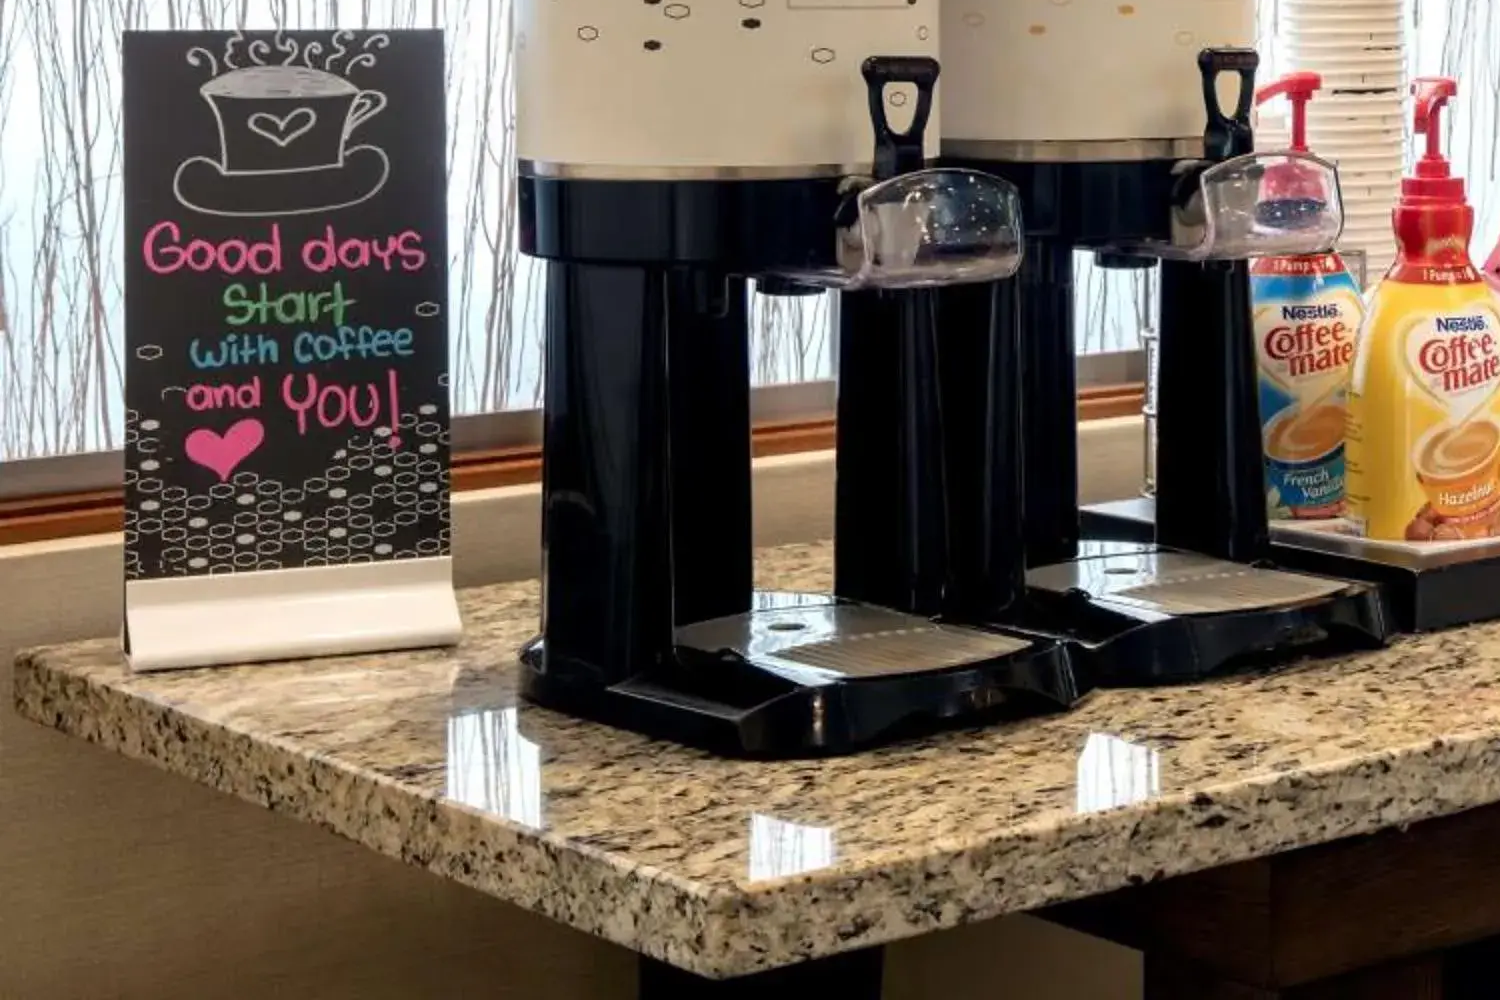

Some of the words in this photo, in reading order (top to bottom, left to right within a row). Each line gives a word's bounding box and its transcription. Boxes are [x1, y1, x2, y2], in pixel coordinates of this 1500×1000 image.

[143, 220, 282, 274] Good
[302, 224, 426, 273] days
[189, 333, 279, 369] with
[1288, 342, 1353, 377] mate
[1443, 355, 1500, 391] mate
[185, 375, 261, 411] and
[1283, 466, 1330, 488] French
